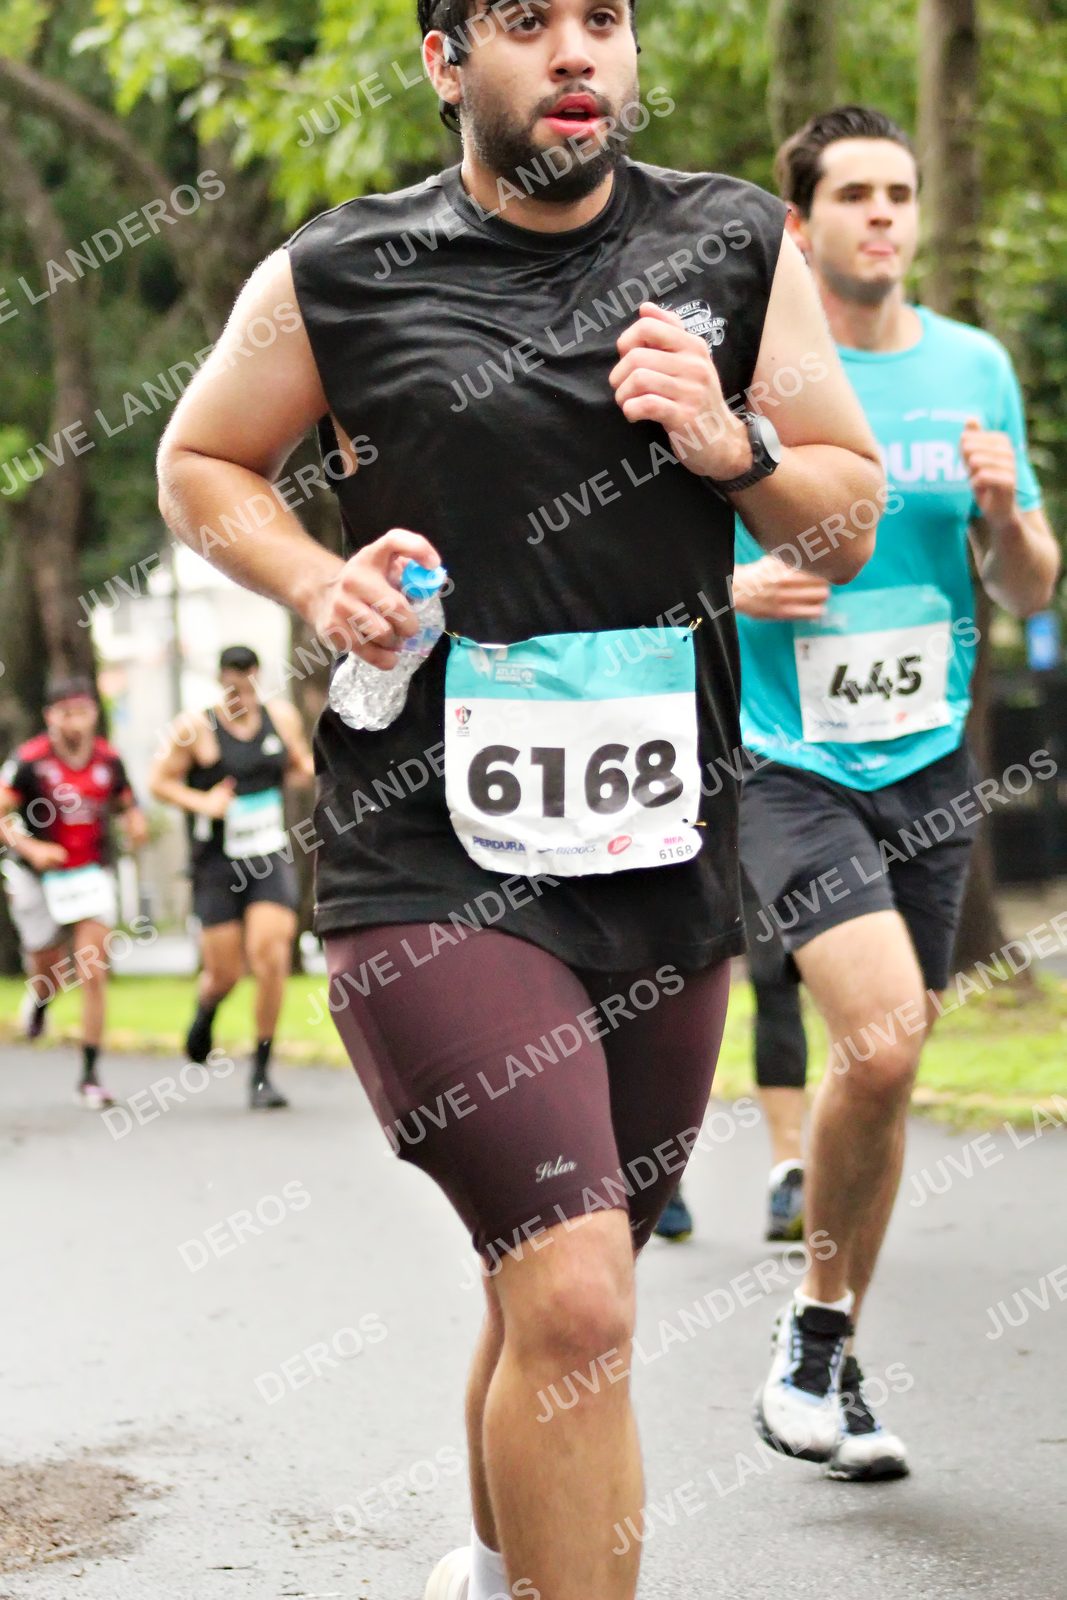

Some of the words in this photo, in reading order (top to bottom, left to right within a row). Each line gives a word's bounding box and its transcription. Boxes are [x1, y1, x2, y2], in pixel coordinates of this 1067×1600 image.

[829, 655, 922, 704] 445
[467, 739, 684, 818] 6168
[472, 836, 526, 852] PERDURA
[659, 845, 693, 860] 6168
